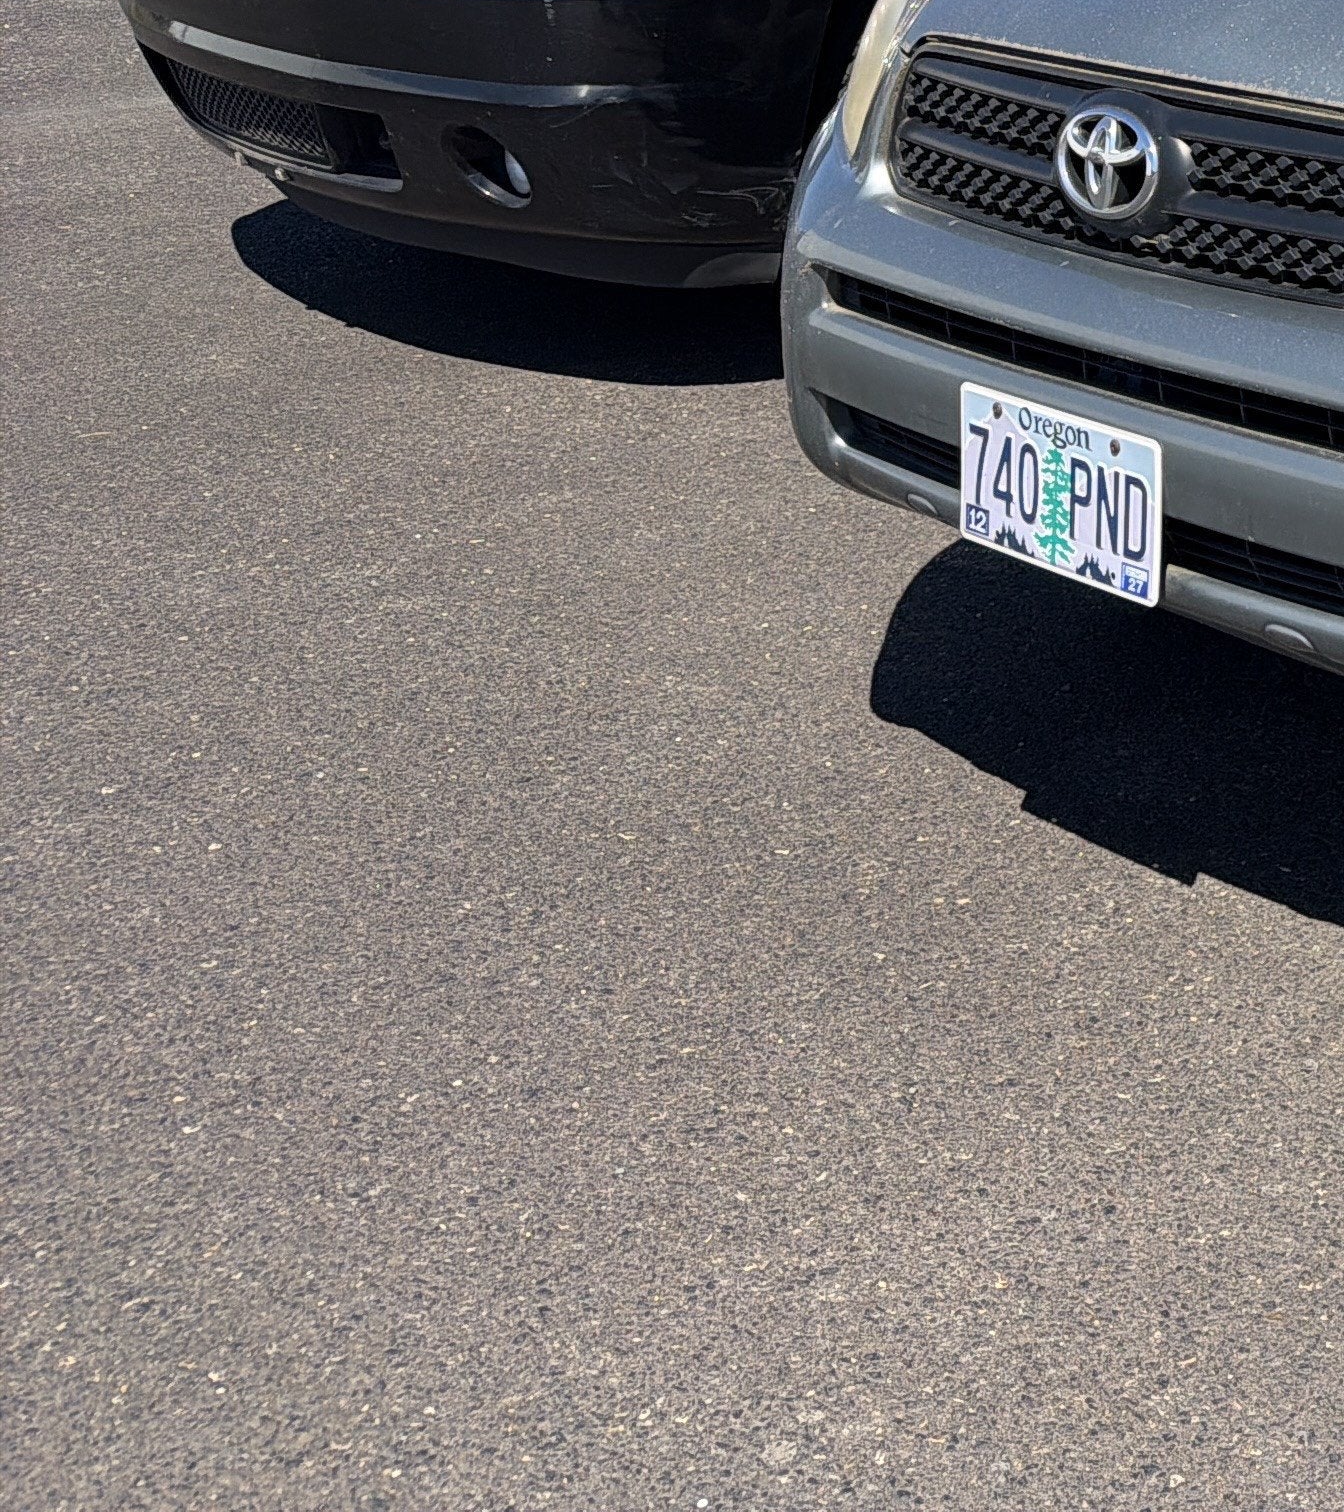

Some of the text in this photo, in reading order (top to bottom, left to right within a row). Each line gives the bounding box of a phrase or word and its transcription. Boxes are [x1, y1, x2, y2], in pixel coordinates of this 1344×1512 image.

[1018, 406, 1092, 451] Oregon
[969, 422, 1148, 563] 740 PND
[968, 508, 987, 535] 12
[1127, 577, 1144, 594] 27
